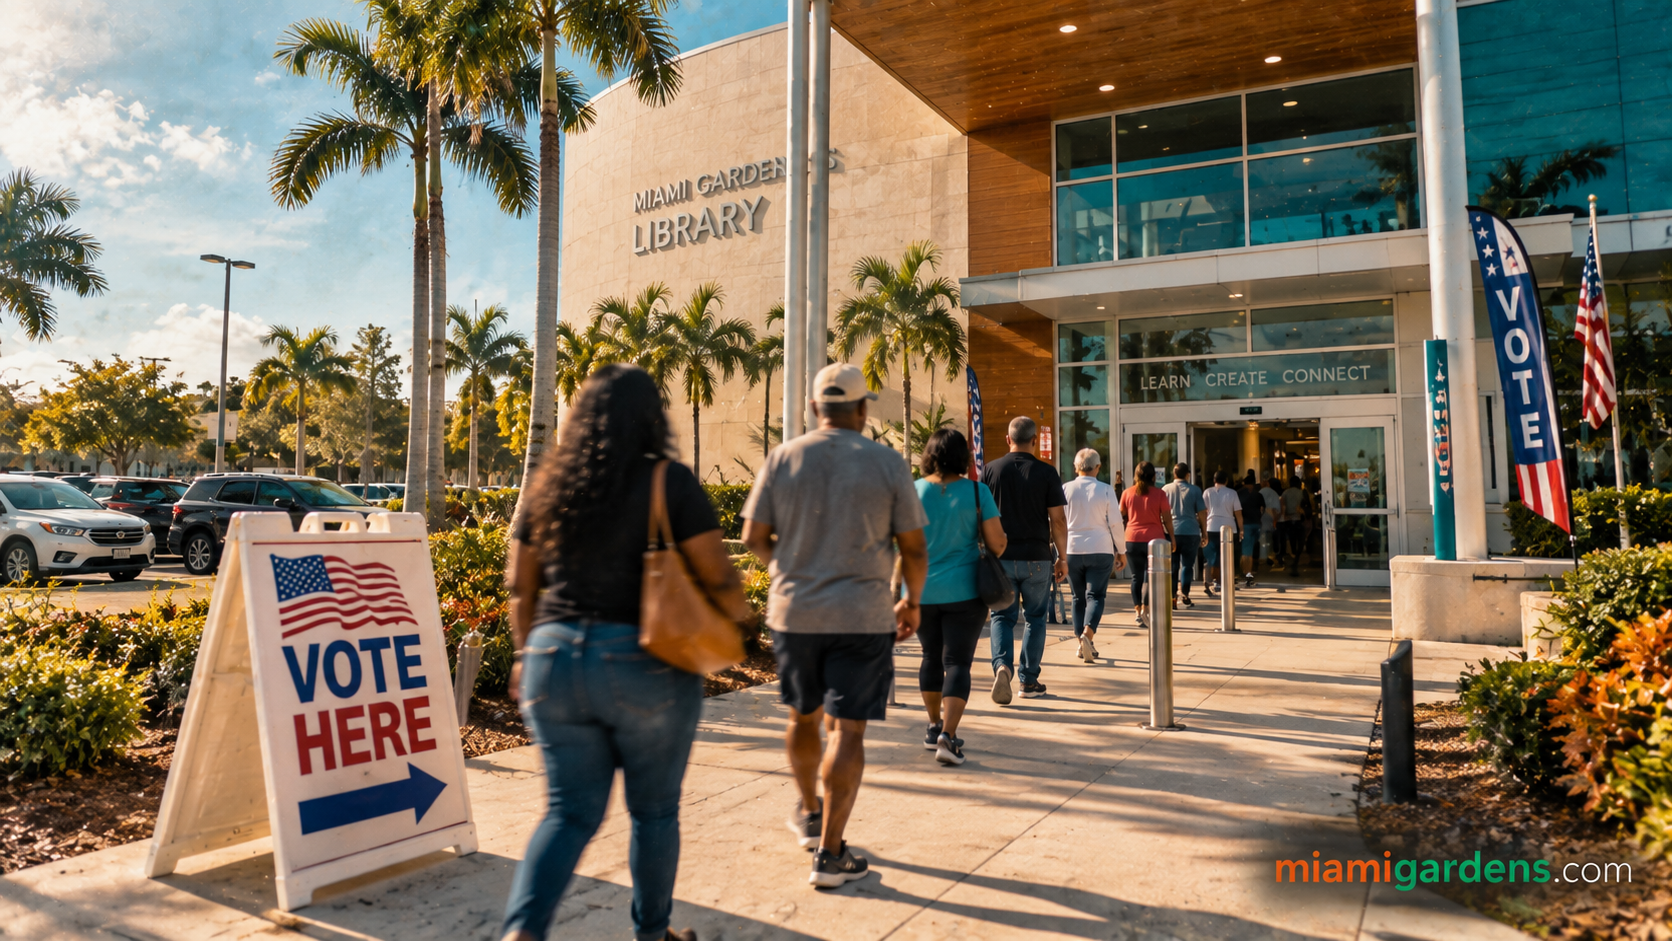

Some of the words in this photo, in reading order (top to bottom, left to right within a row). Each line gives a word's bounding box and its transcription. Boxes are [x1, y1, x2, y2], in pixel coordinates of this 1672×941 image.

[633, 195, 764, 254] LIBRARY
[634, 178, 689, 213] MIAMI
[1140, 373, 1192, 391] LEARN
[1205, 370, 1268, 388] CREATE
[1282, 365, 1372, 384] CONNECT
[1495, 285, 1544, 450] VOTE
[281, 633, 428, 704] VOTE
[293, 695, 437, 777] HERE
